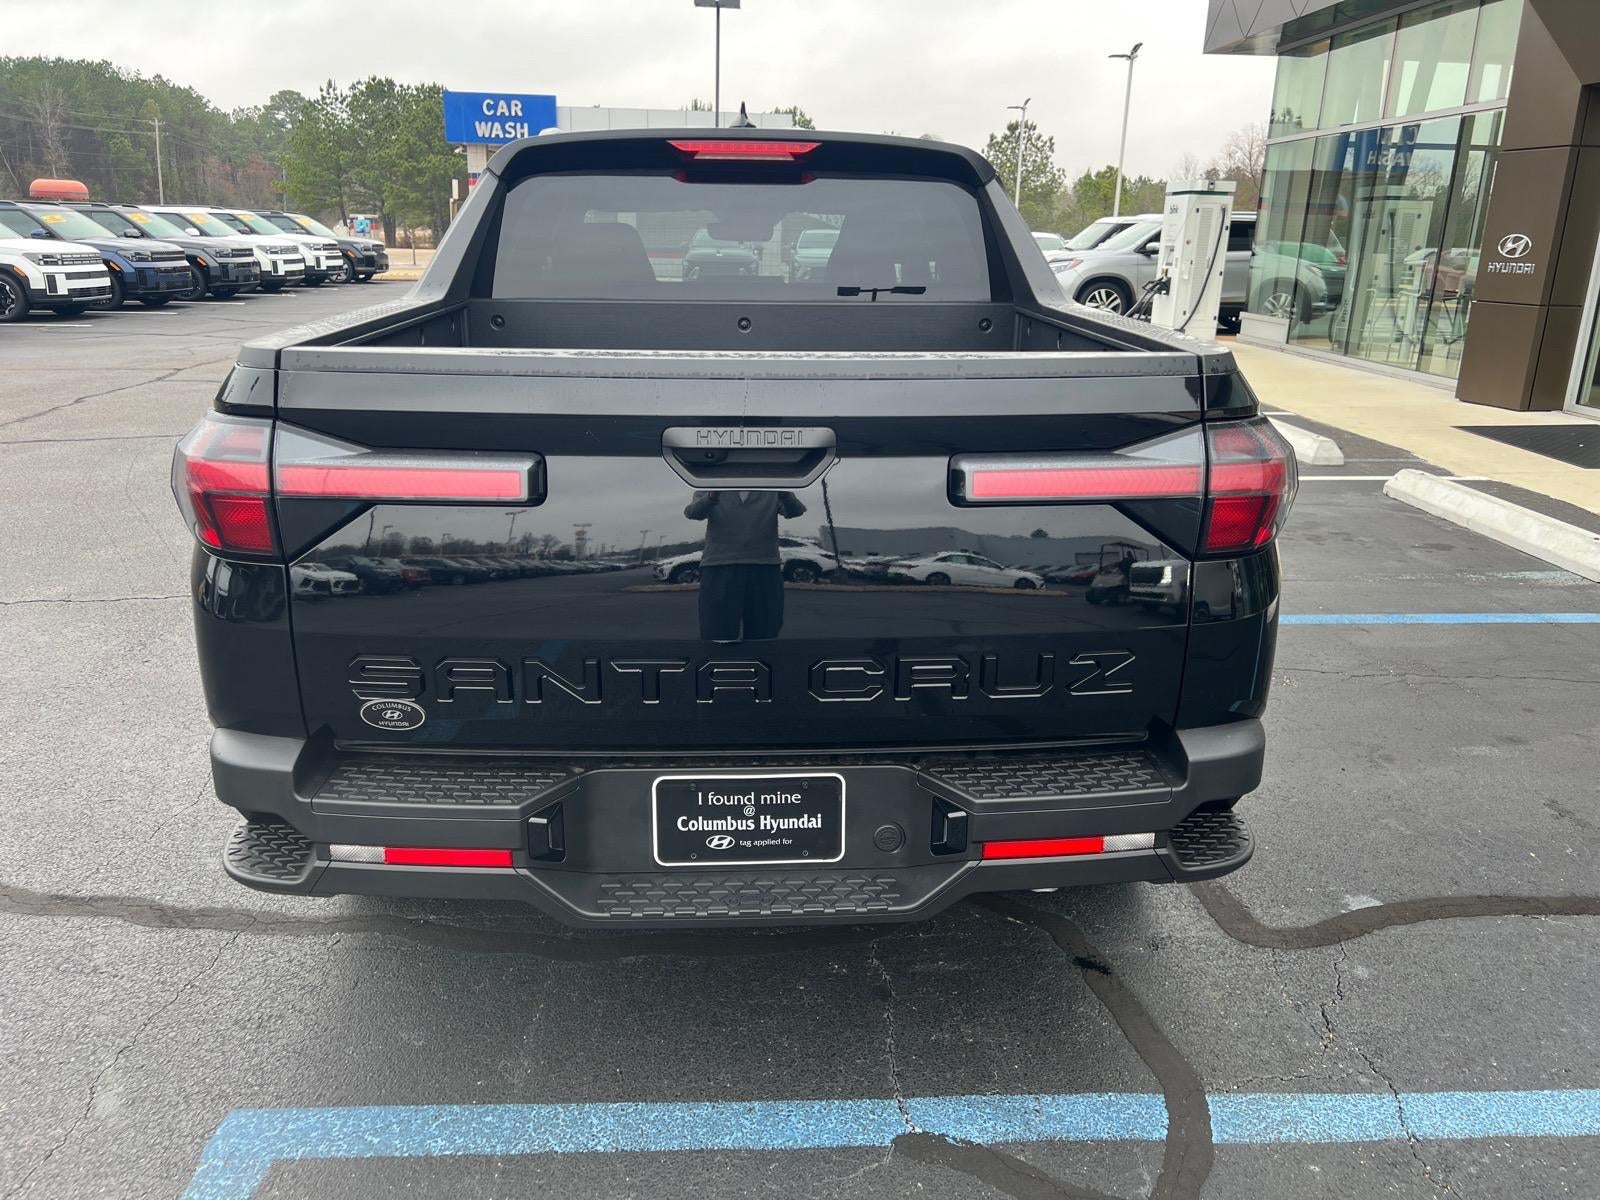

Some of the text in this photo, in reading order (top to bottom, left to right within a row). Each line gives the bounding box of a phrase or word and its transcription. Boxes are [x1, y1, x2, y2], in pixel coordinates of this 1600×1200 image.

[482, 99, 523, 117] CAR
[475, 121, 529, 139] WASH
[1487, 262, 1535, 274] HYUNDAI
[696, 430, 803, 446] HYUNDAI
[348, 650, 1136, 705] SANTA CRUZ
[371, 702, 412, 712] COLUMBUS
[698, 791, 802, 806] I found mine
[743, 805, 756, 817] @
[676, 814, 823, 834] Columbus Hyundai
[739, 838, 752, 847] tag
[753, 838, 780, 847] applied
